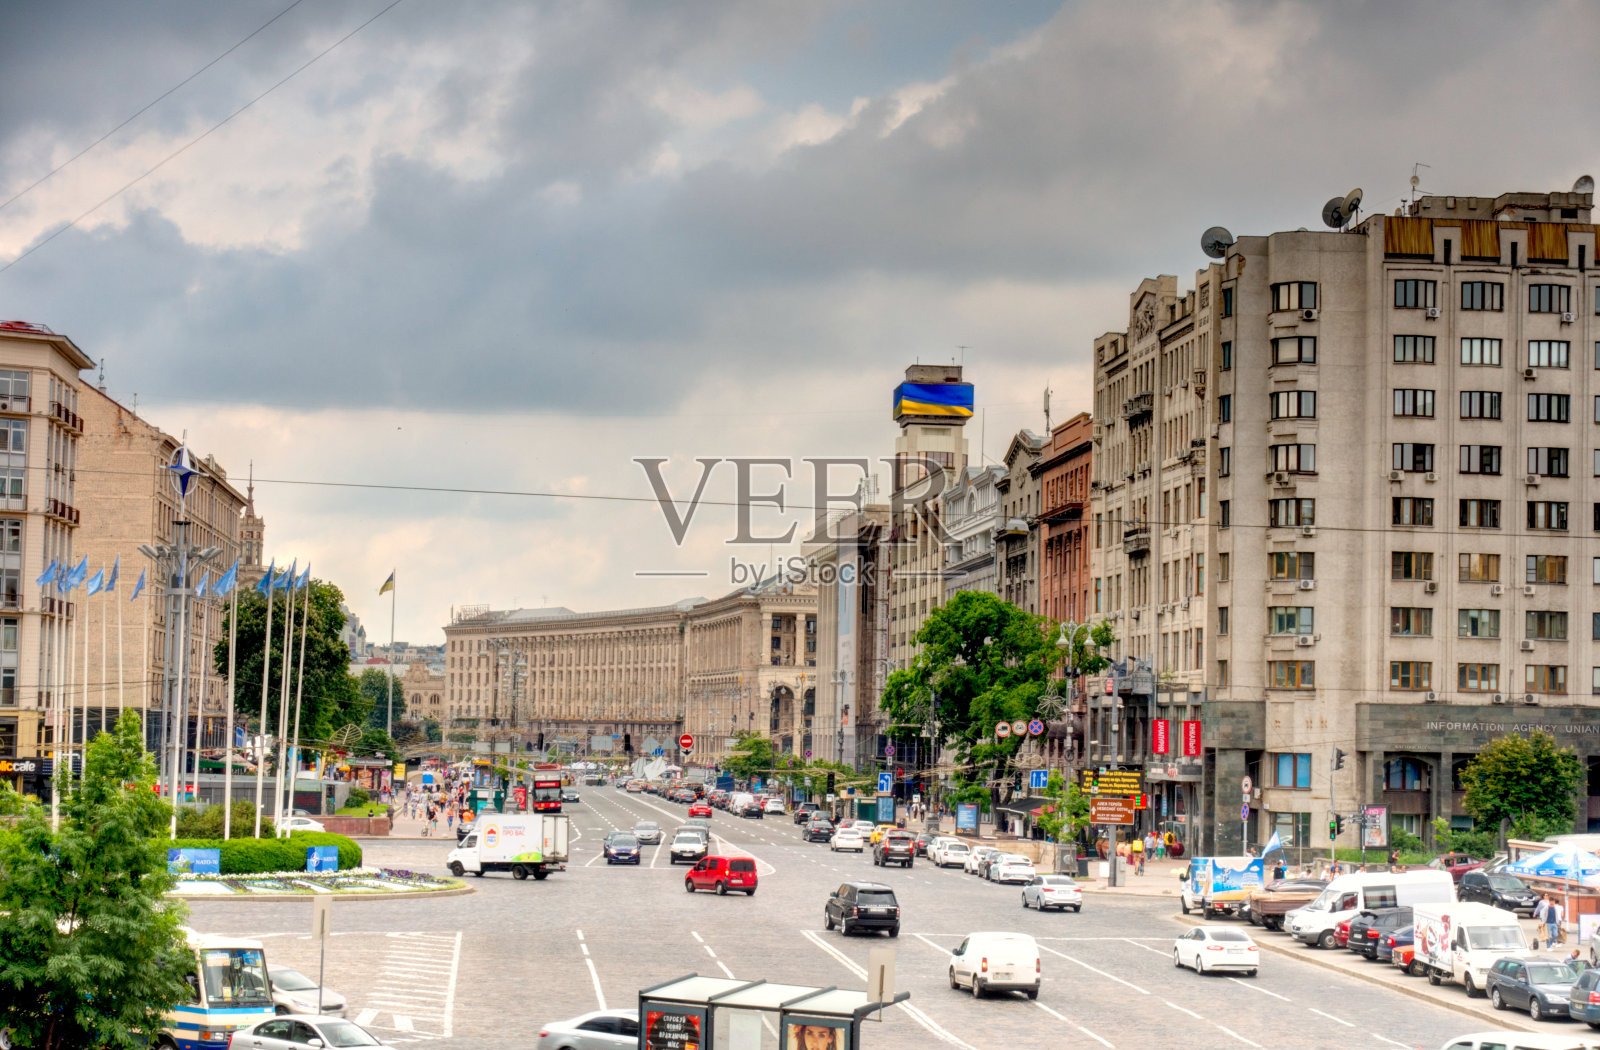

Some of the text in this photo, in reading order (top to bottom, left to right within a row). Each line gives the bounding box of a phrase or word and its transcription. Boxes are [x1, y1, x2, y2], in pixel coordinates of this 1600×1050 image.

[1426, 721, 1504, 732] INFORMATION
[1565, 724, 1600, 734] UNIAN
[0, 760, 36, 772] liccafe
